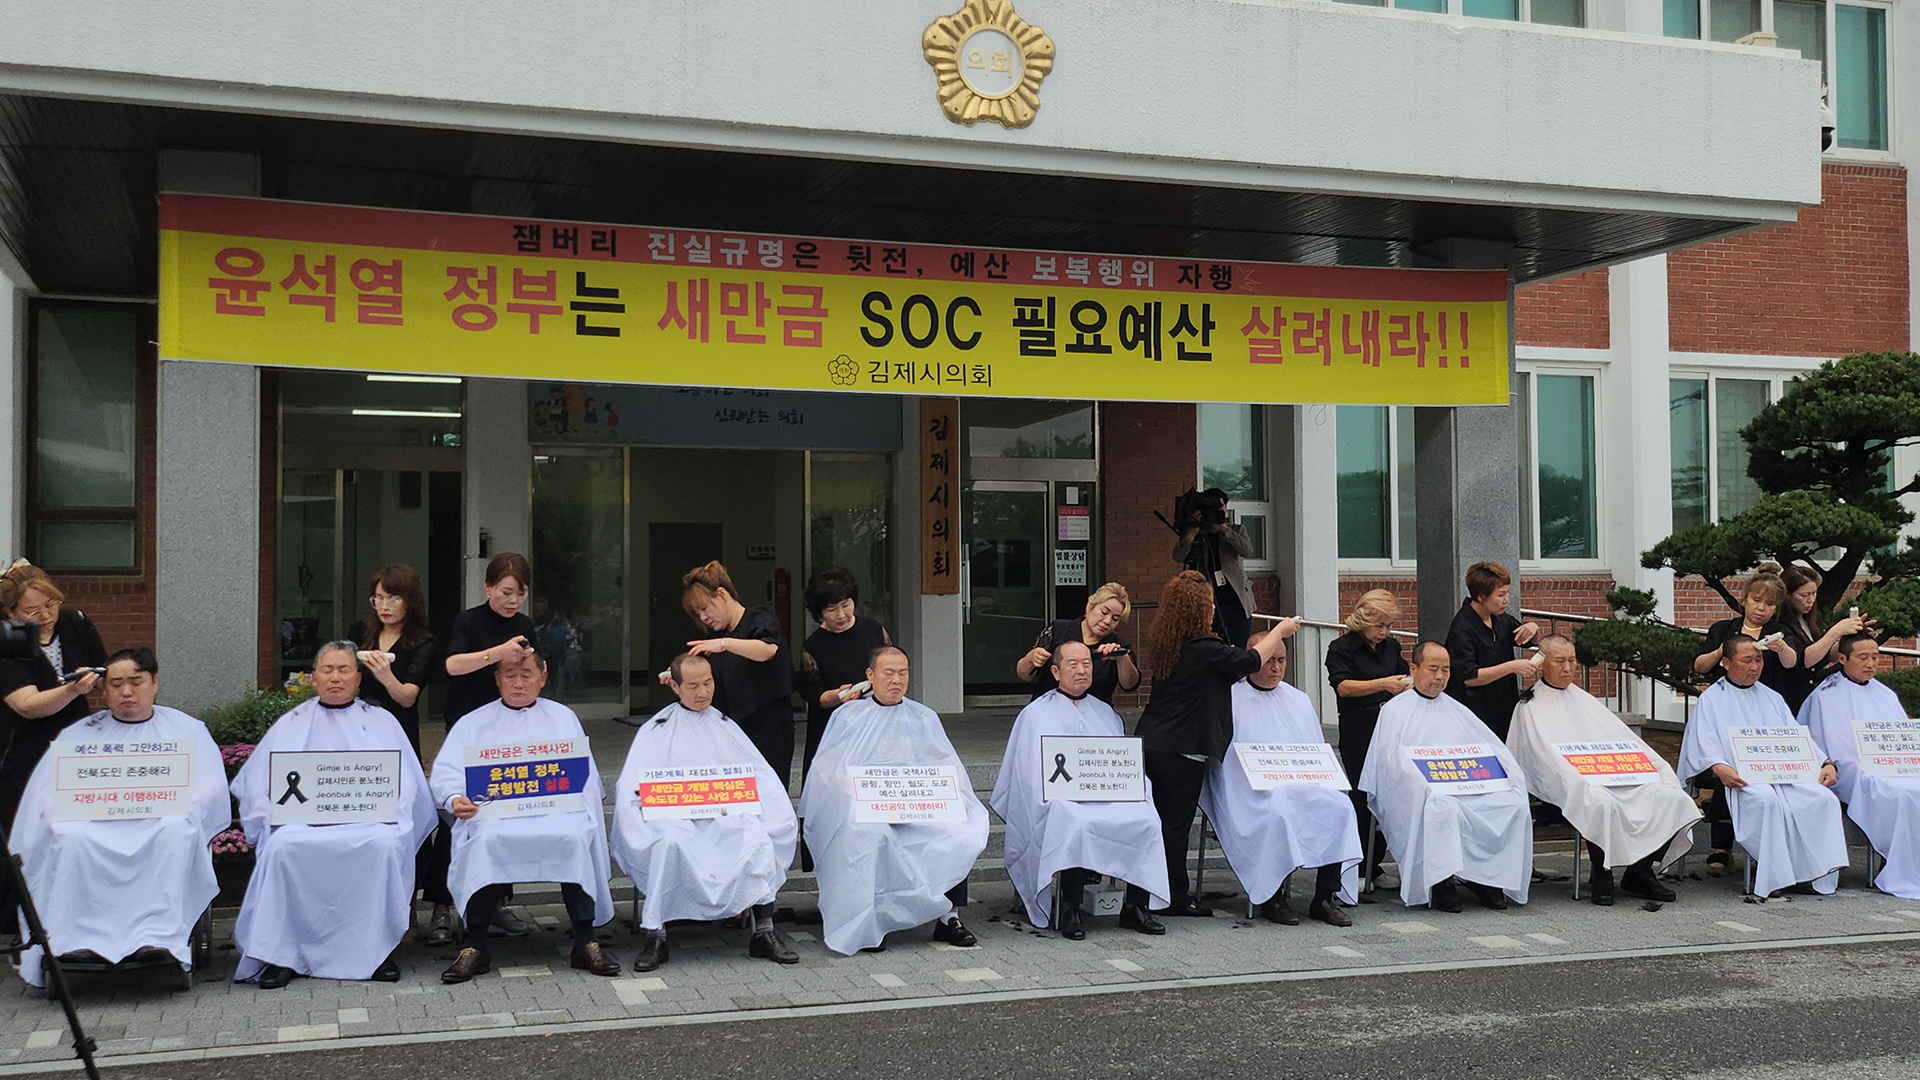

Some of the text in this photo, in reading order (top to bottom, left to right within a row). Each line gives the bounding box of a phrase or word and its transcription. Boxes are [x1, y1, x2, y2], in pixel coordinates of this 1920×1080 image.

[967, 48, 1012, 78] 의회
[513, 224, 1233, 289] 잼버리 진실규명은 뒷전, 예산 보복행위 자행
[208, 247, 1471, 368] 윤석열 정부는 새만금 SOC 필요예산 살려내라!!
[868, 360, 992, 387] 김제시의회
[714, 408, 804, 425] 신뢰받는 의회
[929, 415, 951, 578] 김제시의회
[1865, 721, 1892, 730] 새만금은
[1770, 728, 1800, 736] 그만하고!
[75, 742, 178, 754] 예산 폭력 그만하고!
[479, 742, 574, 760] 새만금은 국책사업!
[1077, 747, 1097, 755] Gimje
[1746, 745, 1772, 753] 전북도인
[316, 763, 383, 773] Gimje is Angry!
[1078, 759, 1136, 767] 김제시민은 분노한다
[1749, 764, 1776, 772] 지방시대
[77, 766, 171, 778] 전북도인 존중해라
[489, 763, 566, 781] 윤석열 정부,
[644, 769, 685, 779] 기본계획
[688, 768, 719, 777] 재검토
[722, 766, 742, 775] 철회
[864, 767, 940, 776] 새만금은 국책사업!
[1117, 771, 1140, 779] Angry!
[317, 776, 390, 786] 김제시민은 분노한다
[650, 780, 746, 794] 새만금 개발 핵심은
[73, 790, 177, 804] 지방시대 이행하라!!
[316, 791, 352, 799] Jeonbuk
[365, 790, 394, 799] Angry!
[644, 790, 756, 805] 속도감 있는 사업 추진
[879, 789, 935, 798] 예산 살려내고
[108, 806, 153, 815] 김제시의회
[316, 803, 377, 812] 전북은 분노한다!
[517, 800, 556, 811] 김제시의회
[870, 802, 948, 811] 대선공약 이행하라!
